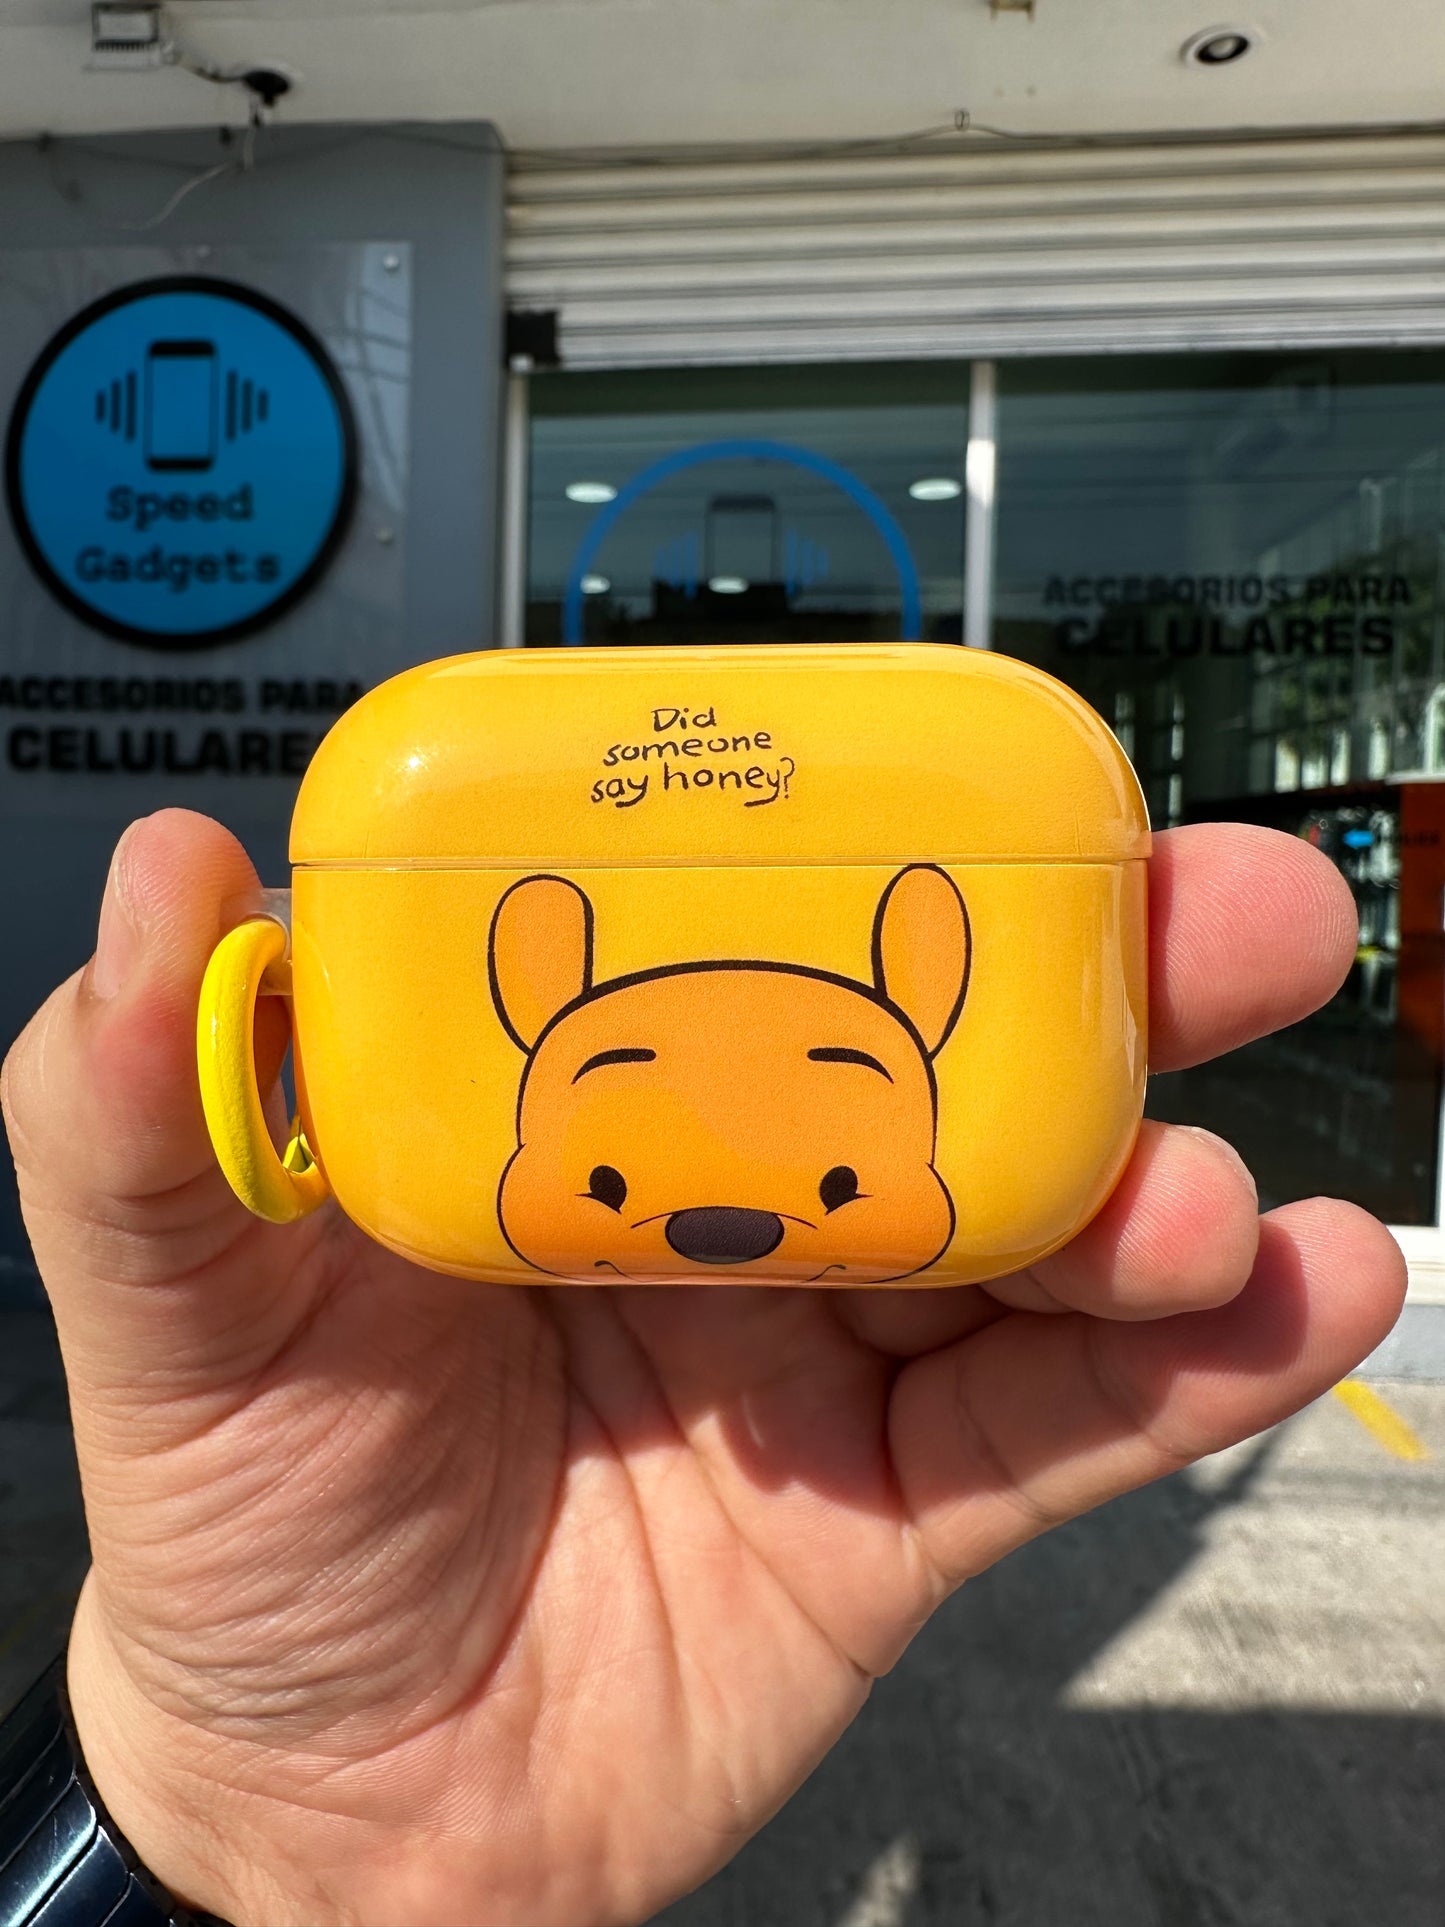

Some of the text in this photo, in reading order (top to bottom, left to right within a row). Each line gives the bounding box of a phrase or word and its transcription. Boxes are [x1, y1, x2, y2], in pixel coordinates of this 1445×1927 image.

[105, 483, 254, 531] Speed
[75, 545, 281, 593] Gadgets
[1043, 573, 1411, 607] ACCESORIOS PARA
[1054, 615, 1395, 657] CELULARES
[0, 677, 245, 714] ACCESORIOS
[651, 706, 717, 732] Did
[8, 727, 336, 776] CELULARE
[602, 731, 772, 767] someone
[590, 756, 795, 808] say honey?
